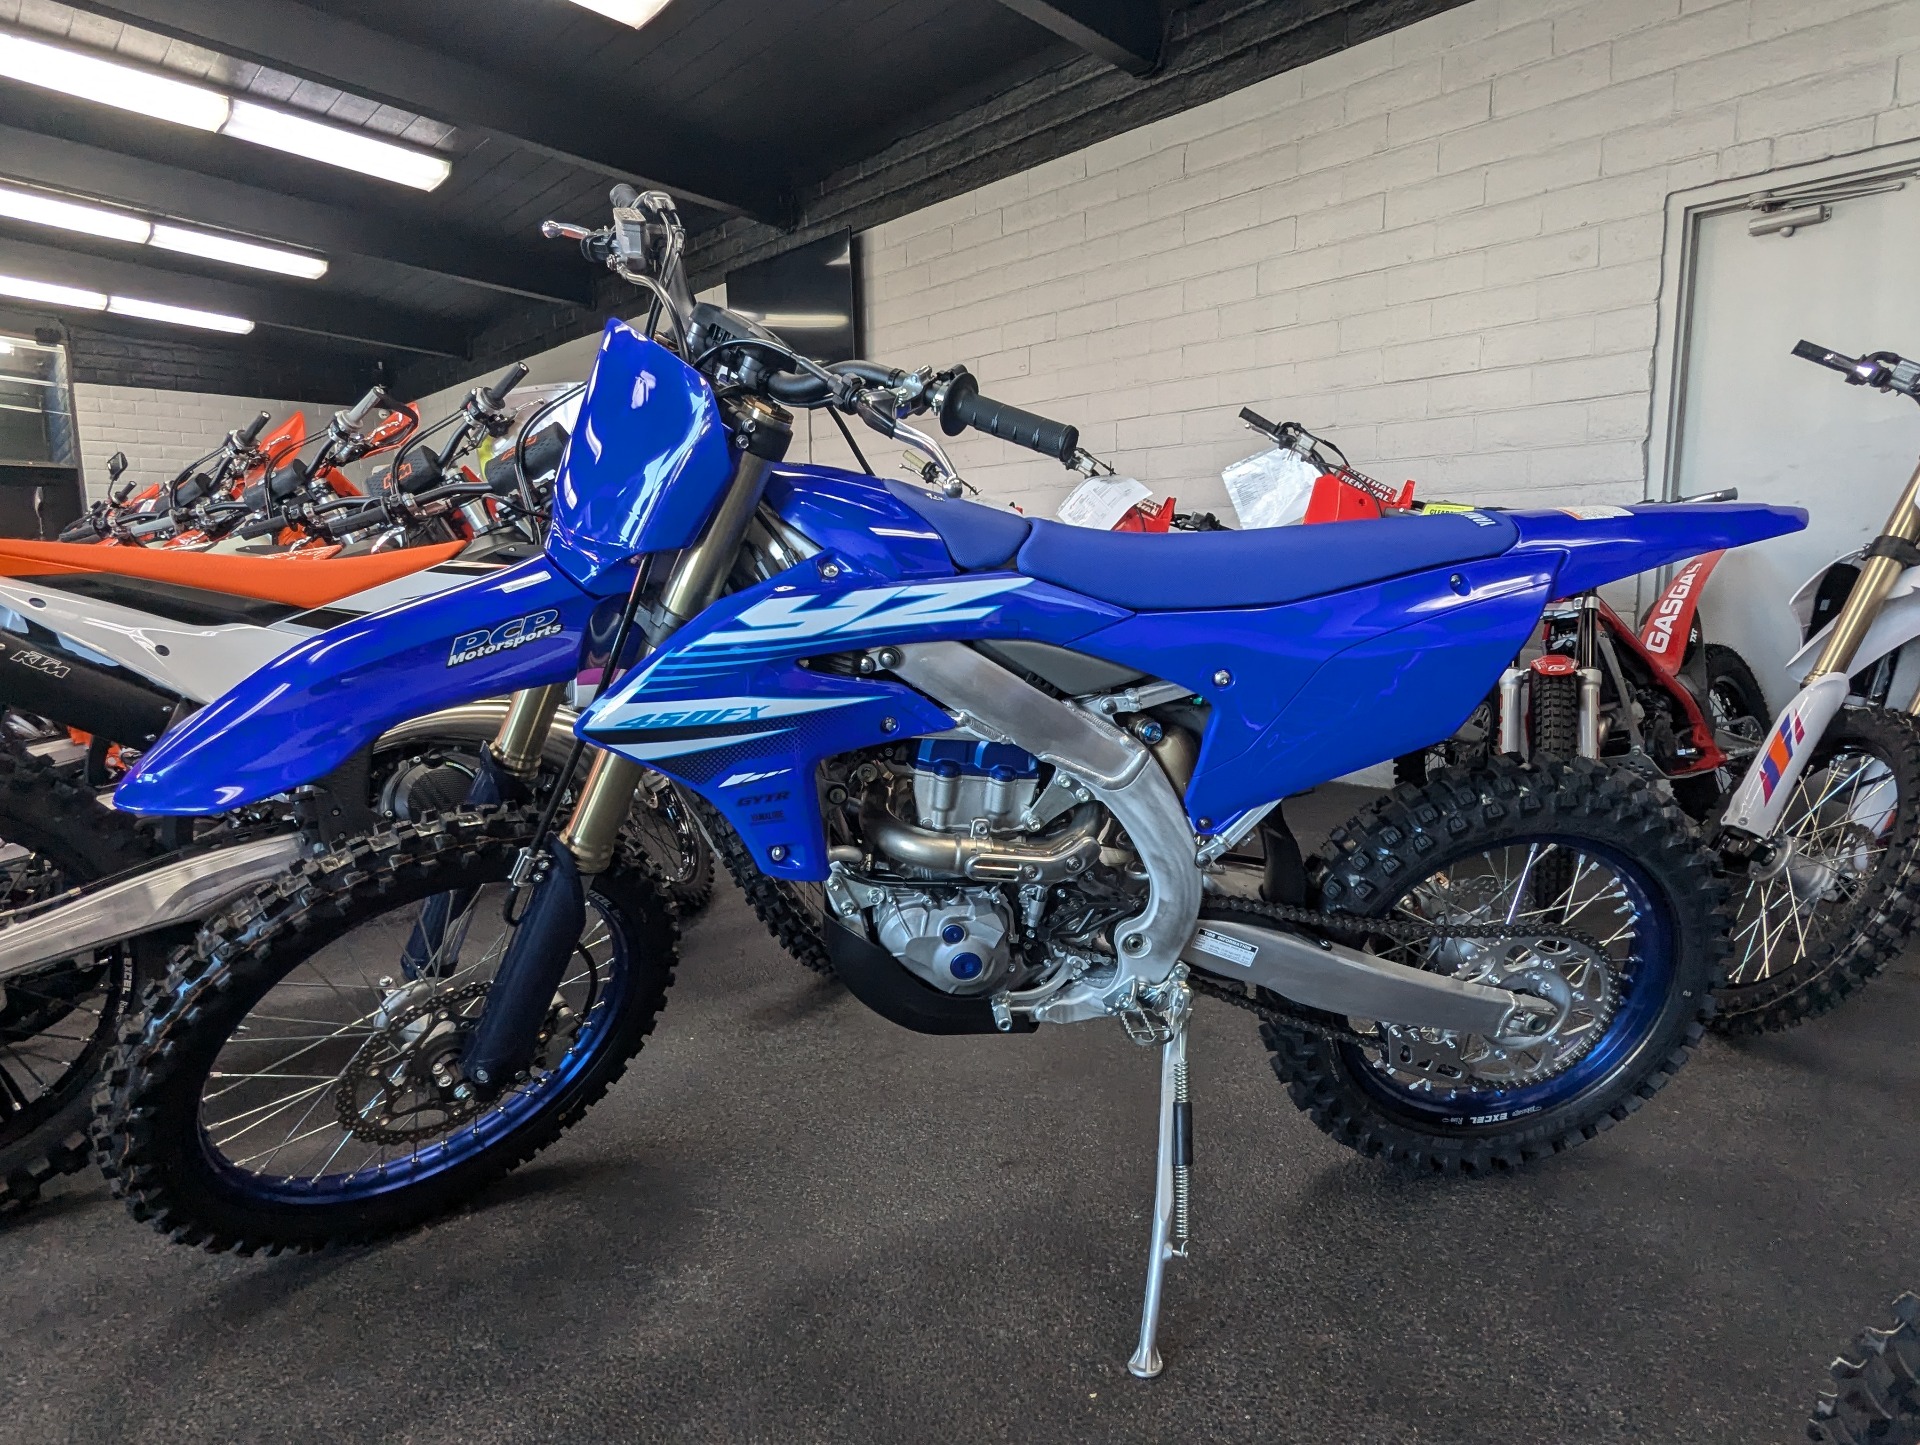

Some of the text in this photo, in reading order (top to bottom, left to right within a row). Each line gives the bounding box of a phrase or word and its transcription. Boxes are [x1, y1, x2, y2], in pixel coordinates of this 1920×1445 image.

[735, 577, 1035, 636] YZ
[1645, 562, 1703, 654] GASGAS
[9, 650, 71, 679] KTM
[447, 624, 562, 667] Motorsports
[615, 704, 771, 729] 450FX
[123, 957, 133, 995] EXCEL
[1469, 1112, 1508, 1124] EXCEL
